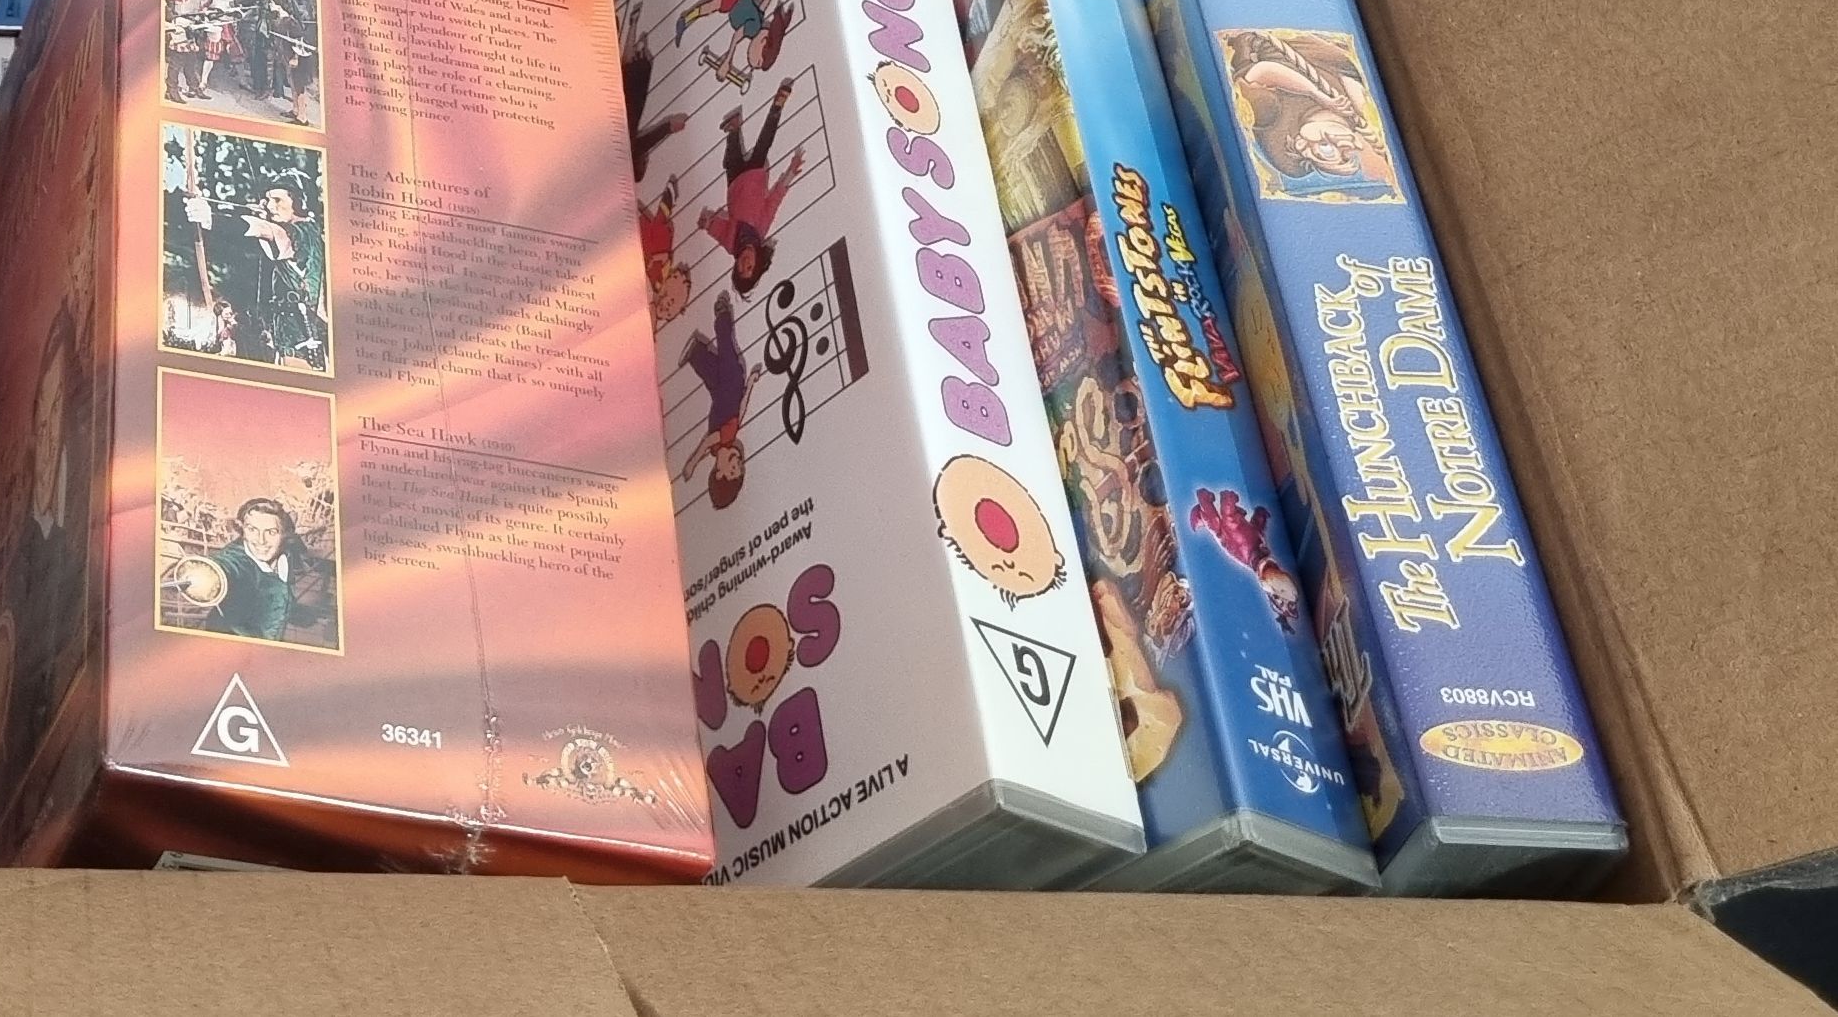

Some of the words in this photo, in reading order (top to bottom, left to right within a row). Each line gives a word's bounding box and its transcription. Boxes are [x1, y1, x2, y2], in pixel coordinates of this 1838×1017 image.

[348, 163, 378, 181] The
[383, 170, 470, 196] Adventures
[474, 185, 491, 200] of
[349, 182, 394, 201] Robin
[401, 191, 443, 210] Hood
[1161, 201, 1196, 263] VEGAS
[1177, 260, 1214, 320] ROCK
[1336, 254, 1390, 298] of
[902, 187, 1012, 447] BABY
[1379, 256, 1458, 393] DAME
[1140, 319, 1170, 363] THE
[1202, 315, 1241, 383] VIVA
[358, 415, 391, 434] The
[396, 421, 425, 439] Sea
[431, 427, 477, 447] Hawk
[1314, 284, 1438, 560] HUNCHBACK
[1417, 396, 1525, 566] NOTRE
[764, 510, 789, 541] pen
[791, 496, 814, 521] the
[719, 521, 812, 600] Award-winning
[748, 536, 762, 558] of
[1379, 559, 1460, 633] The
[1012, 642, 1051, 707] G
[1255, 664, 1293, 688] PAL
[1441, 687, 1535, 707] RCV8803
[1250, 676, 1314, 728] VHS
[217, 706, 260, 753] G
[381, 723, 443, 749] 36341
[1443, 722, 1557, 745] CLASSICS
[856, 764, 896, 803] LIVE
[895, 753, 909, 775] A
[1248, 738, 1345, 786] UNIVERSAL
[789, 784, 853, 838] ACTION
[733, 820, 787, 879] MUSIC
